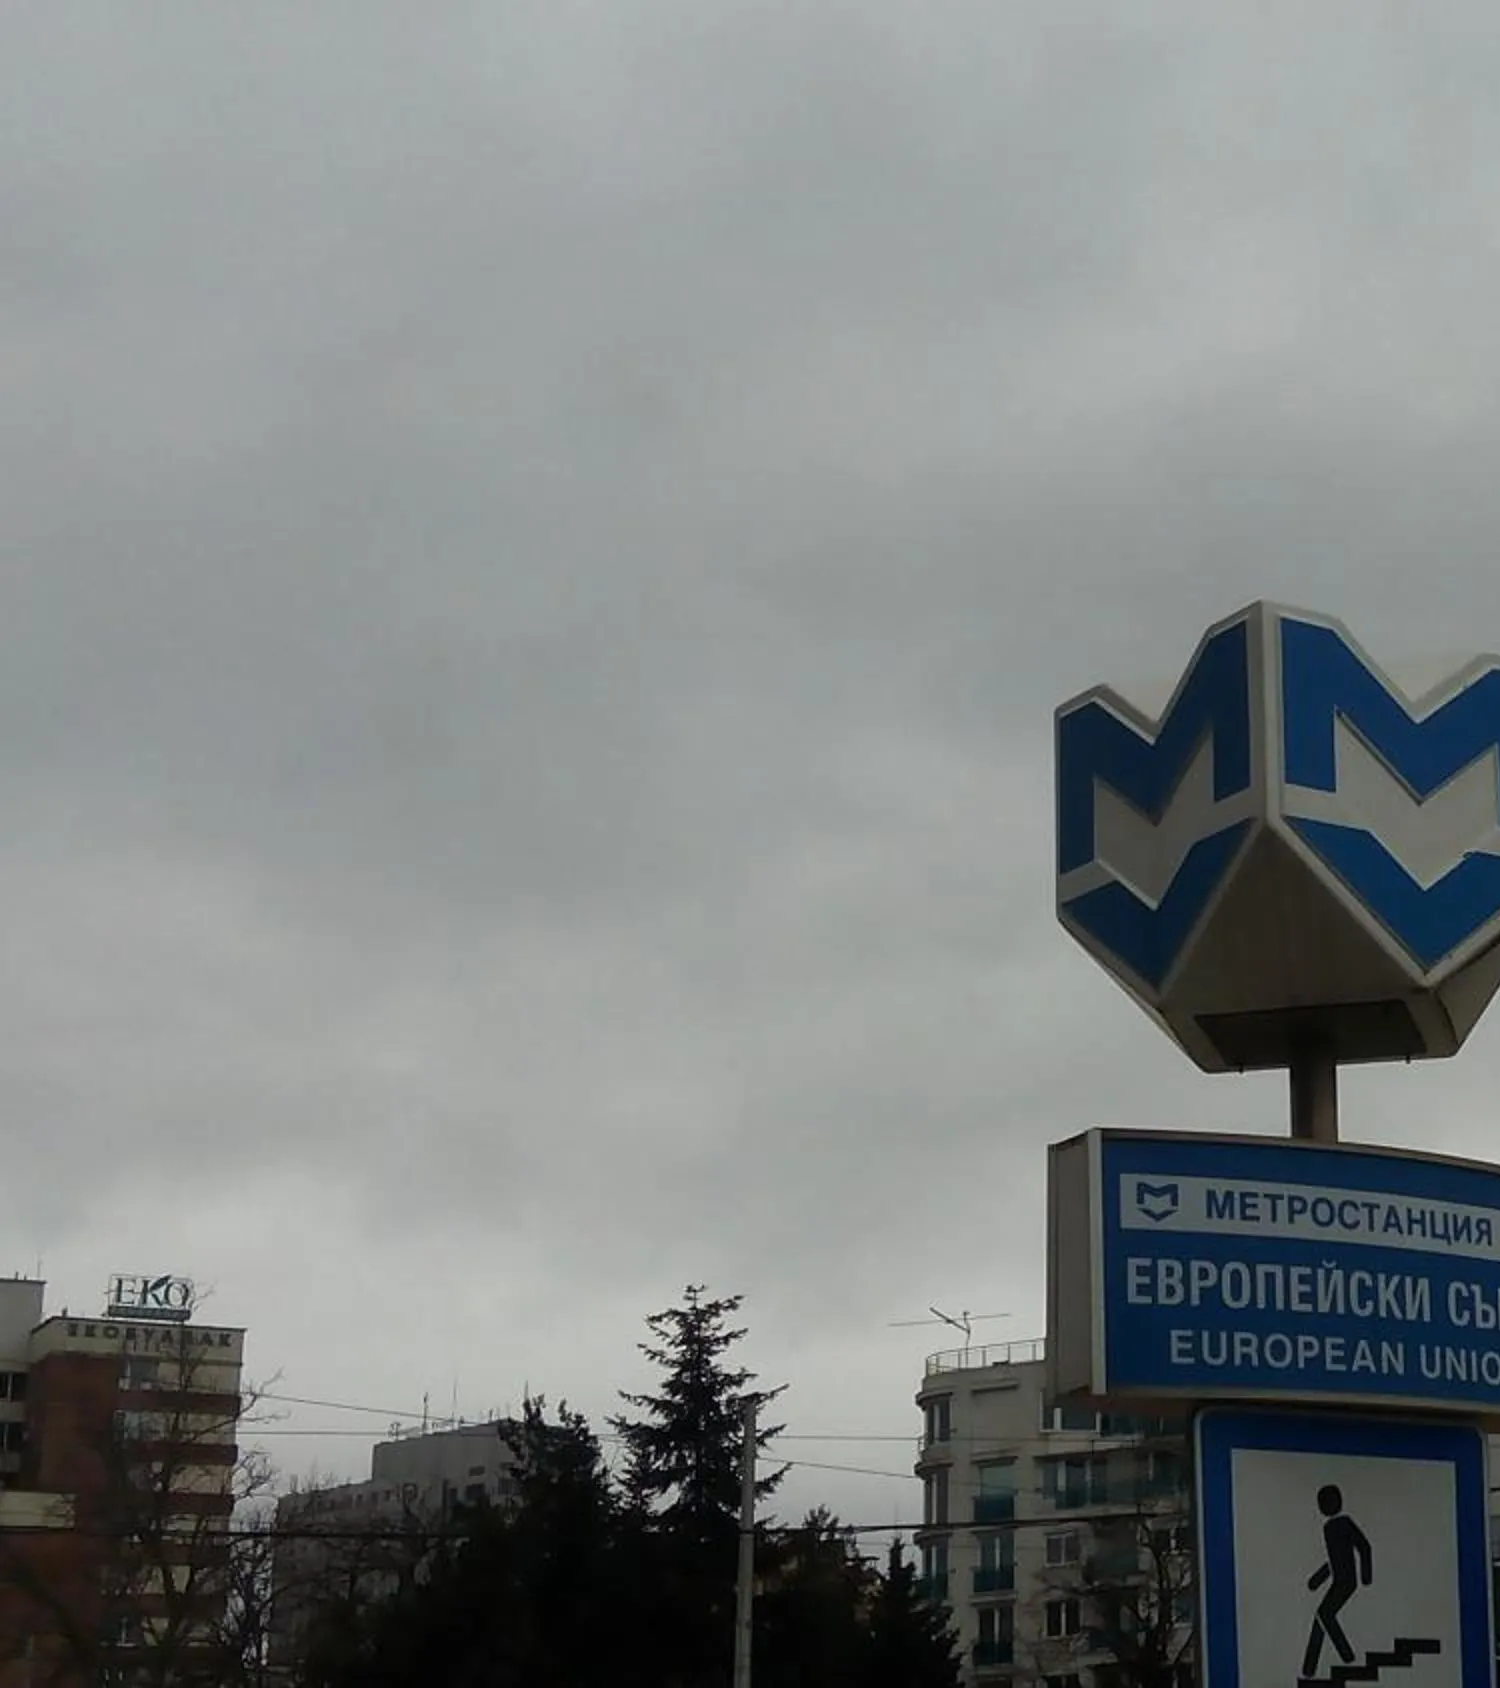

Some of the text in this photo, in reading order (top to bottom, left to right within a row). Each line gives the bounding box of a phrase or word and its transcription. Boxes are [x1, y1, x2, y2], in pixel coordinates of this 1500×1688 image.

[1205, 1189, 1493, 1247] МЕТРОСТАНЦИЯ
[1126, 1258, 1432, 1323] ЕВРОПЕЙСКИ
[1169, 1329, 1406, 1376] EUROPEAN
